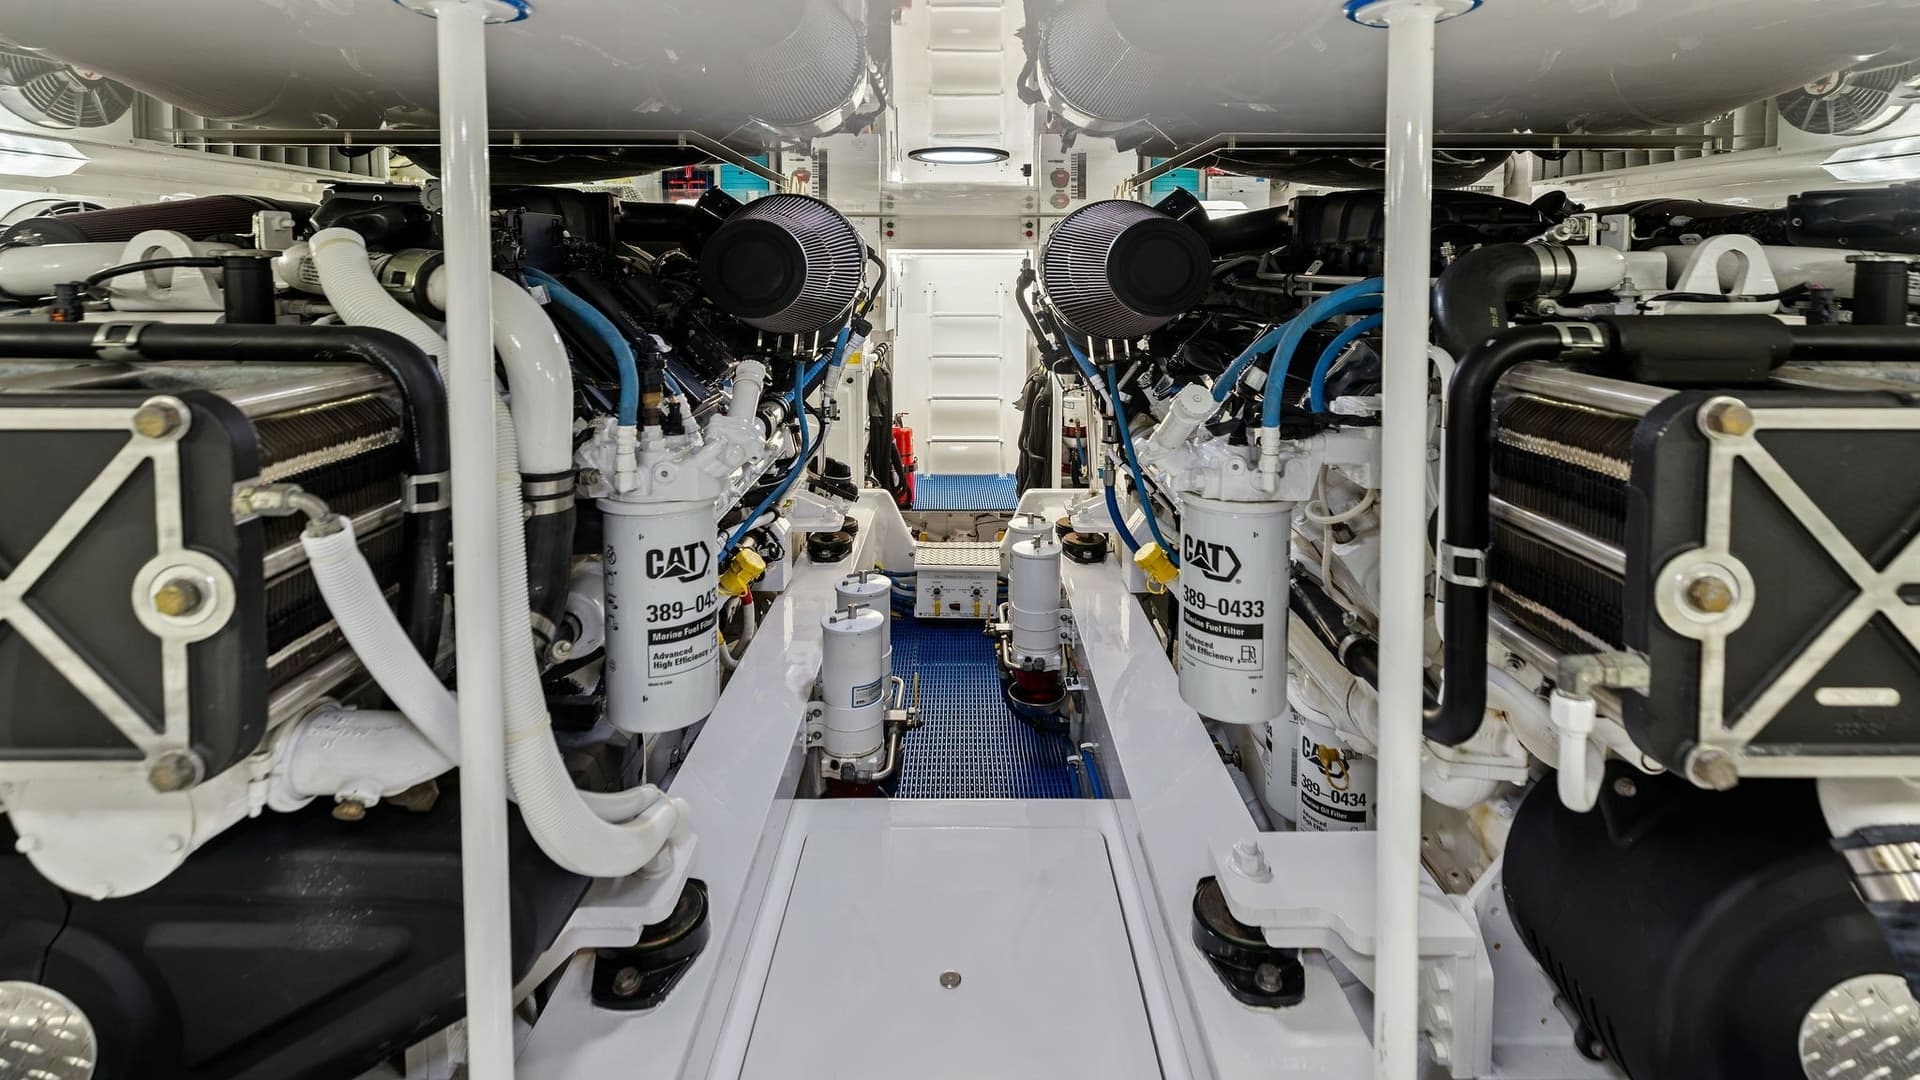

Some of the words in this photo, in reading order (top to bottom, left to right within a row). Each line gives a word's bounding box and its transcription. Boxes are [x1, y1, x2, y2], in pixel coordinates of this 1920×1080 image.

[646, 542, 706, 582] CAT
[1184, 534, 1233, 579] CAT
[1183, 585, 1264, 618] 389-0433
[652, 629, 684, 642] Marine
[684, 623, 700, 637] Fuel
[1205, 622, 1222, 633] Fuel
[1223, 625, 1245, 636] Filter
[653, 645, 693, 661] Advanced
[653, 657, 674, 670] High
[674, 649, 709, 668] Efficiency
[1197, 646, 1233, 663] Efficiency
[1301, 774, 1367, 807] 389-0434
